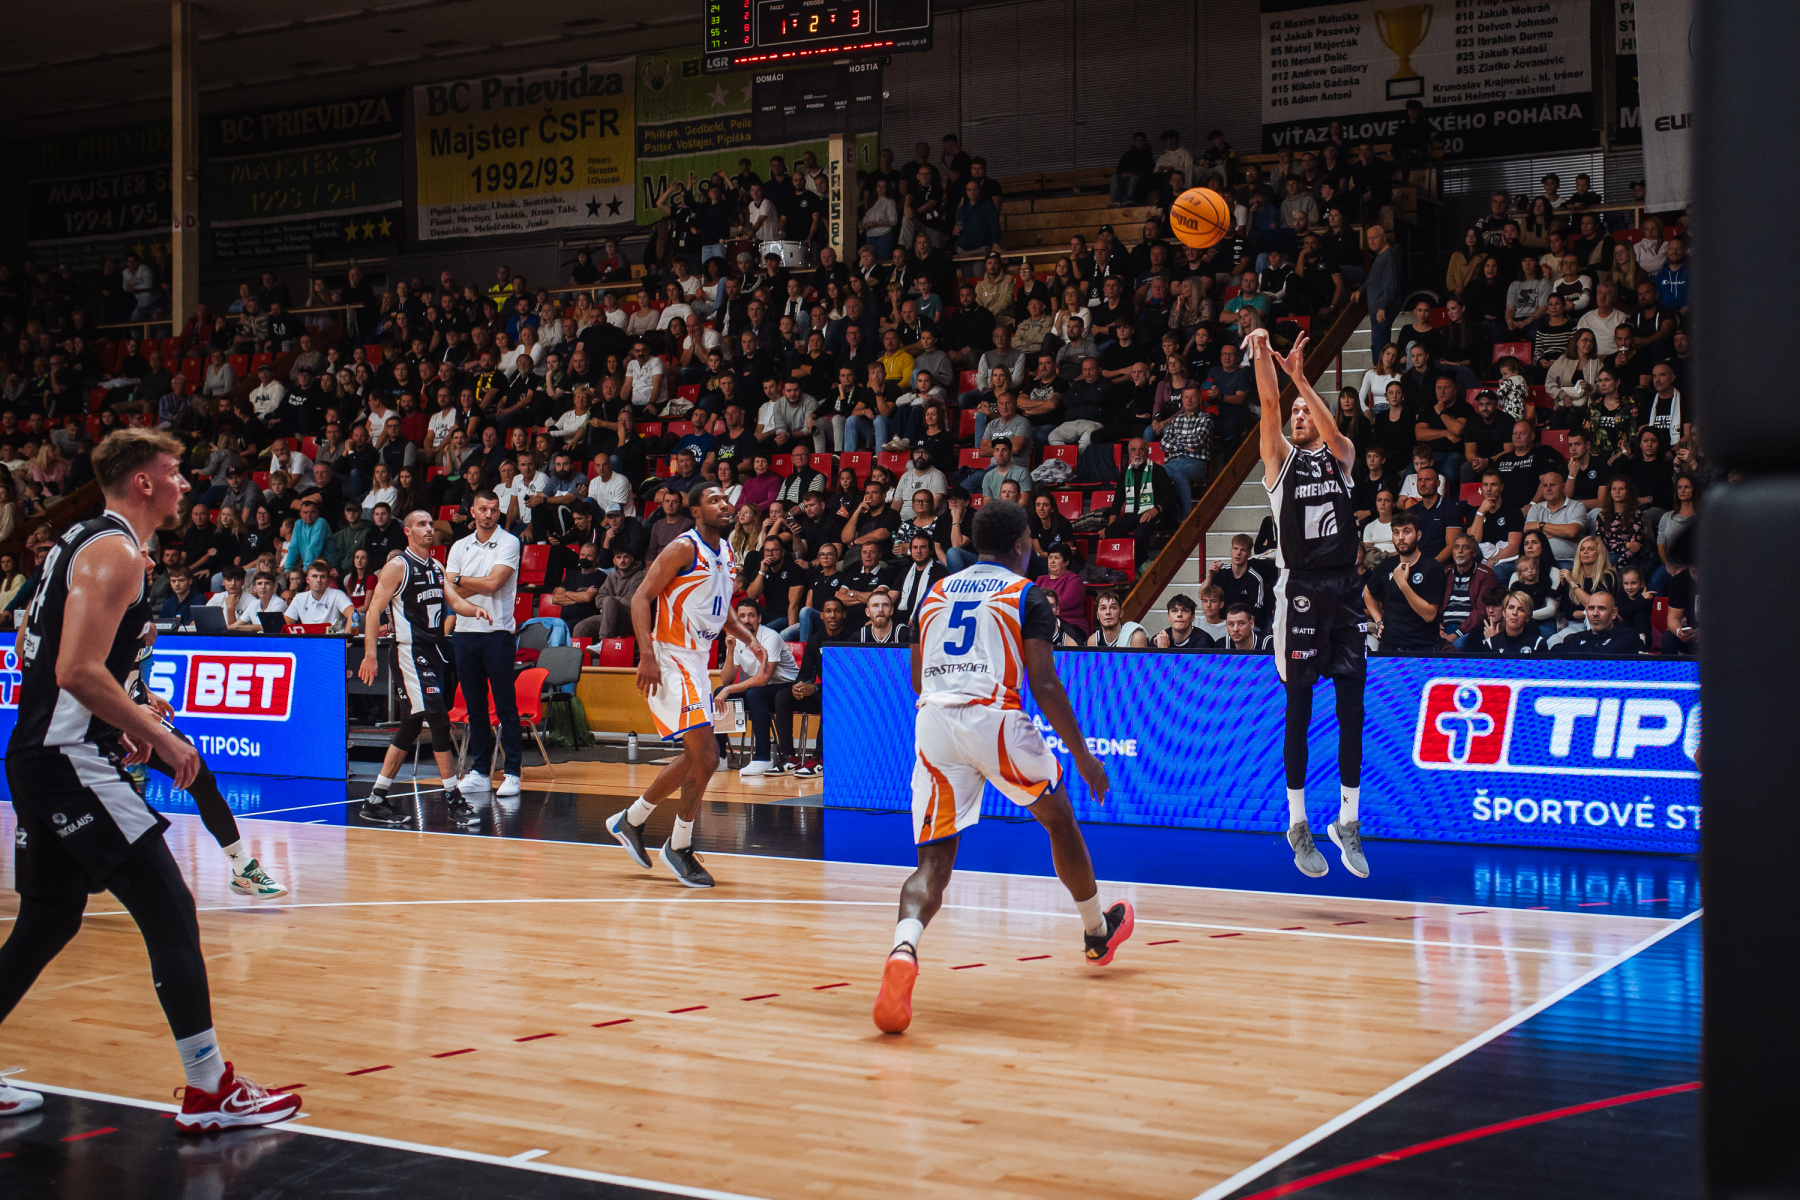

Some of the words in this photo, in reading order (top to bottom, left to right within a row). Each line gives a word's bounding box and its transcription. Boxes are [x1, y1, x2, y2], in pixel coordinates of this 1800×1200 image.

[852, 9, 860, 27] 3
[1478, 7, 1508, 20] Jakub
[1512, 4, 1550, 15] Mokrán
[809, 15, 818, 32] 2
[1284, 18, 1315, 29] Maxim
[1318, 12, 1359, 24] Matuška
[1478, 22, 1511, 32] Delvon
[1515, 16, 1558, 28] Johnson
[1284, 30, 1312, 41] Jakub
[1478, 34, 1516, 46] Ibrahim
[1520, 31, 1553, 42] Durmo
[1285, 43, 1311, 54] Matej
[1478, 48, 1509, 59] Jakub
[707, 57, 728, 68] LGR
[849, 63, 878, 73] HOSTIA
[1291, 56, 1320, 66] Nenad
[1478, 61, 1509, 73] Zlatko
[1514, 56, 1564, 69] Jovanović
[756, 72, 784, 83] DOMÁCI
[1292, 68, 1326, 79] Andrew
[426, 82, 471, 116] BC
[481, 64, 623, 110] Prievidza
[1292, 81, 1321, 92] Nikola
[1433, 81, 1481, 92] Krunoslav
[1516, 84, 1556, 96] asistent
[1291, 94, 1317, 105] Adam
[1321, 90, 1352, 101] Antoni
[220, 116, 254, 144] BC
[261, 96, 392, 140] PRIEVIDZA
[1494, 103, 1583, 127] POHÁRA
[430, 122, 529, 160] Majster
[539, 108, 620, 144] ČSFR
[76, 129, 172, 163] PRIEVID
[232, 152, 339, 184] MAJSTER
[471, 156, 574, 193] 1992/93
[48, 173, 147, 205] MAJSTER
[1061, 495, 1068, 503] 28
[1112, 543, 1120, 551] 30
[426, 570, 435, 584] 11
[1152, 572, 1157, 584] 2
[942, 578, 1008, 594] JOHNSON
[712, 596, 722, 616] 11
[943, 600, 981, 656] 5
[924, 662, 991, 678] ERNSTPROFIL
[194, 662, 285, 708] BET
[200, 736, 261, 758] TIPOSu
[1472, 788, 1655, 828] ŠPORTOVÉ
